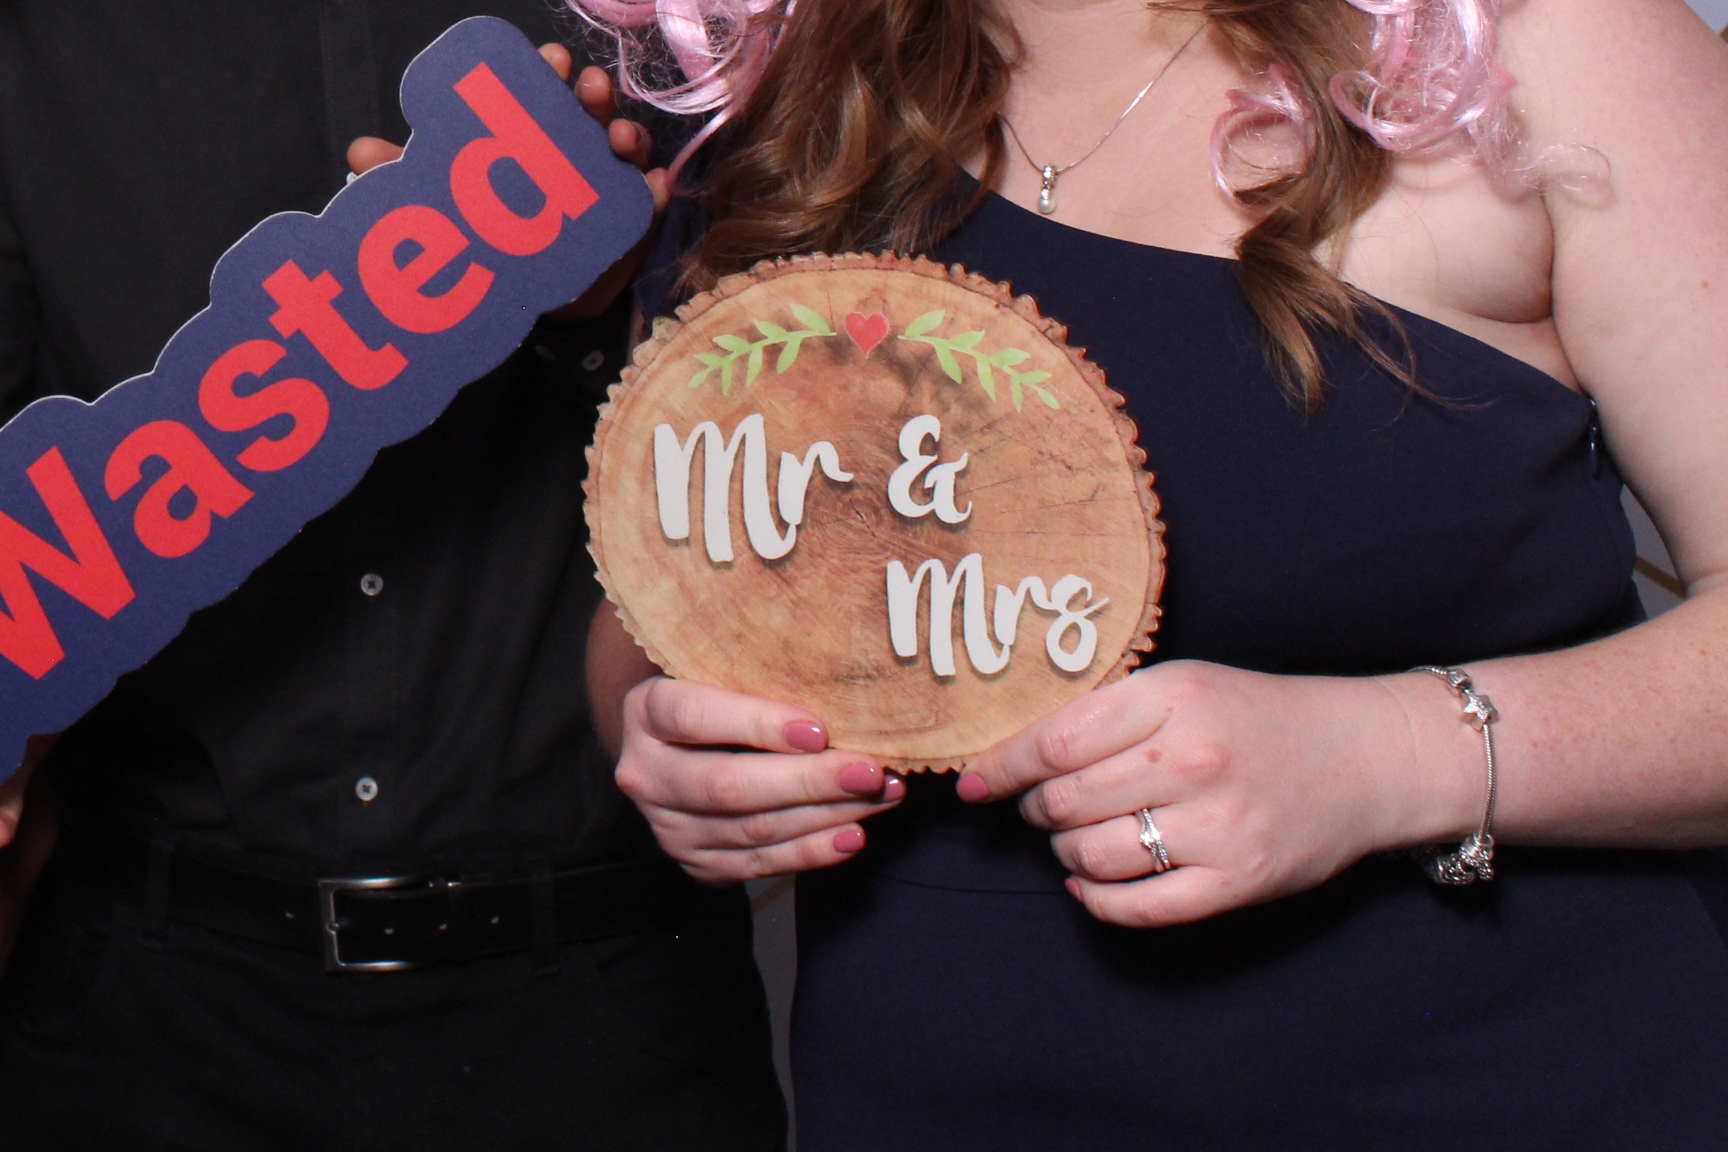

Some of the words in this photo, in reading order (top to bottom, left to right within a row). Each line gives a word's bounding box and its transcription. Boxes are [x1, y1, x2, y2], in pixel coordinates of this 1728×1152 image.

[654, 414, 854, 563] Mr
[887, 414, 972, 524] &
[886, 553, 1110, 677] Mrs
